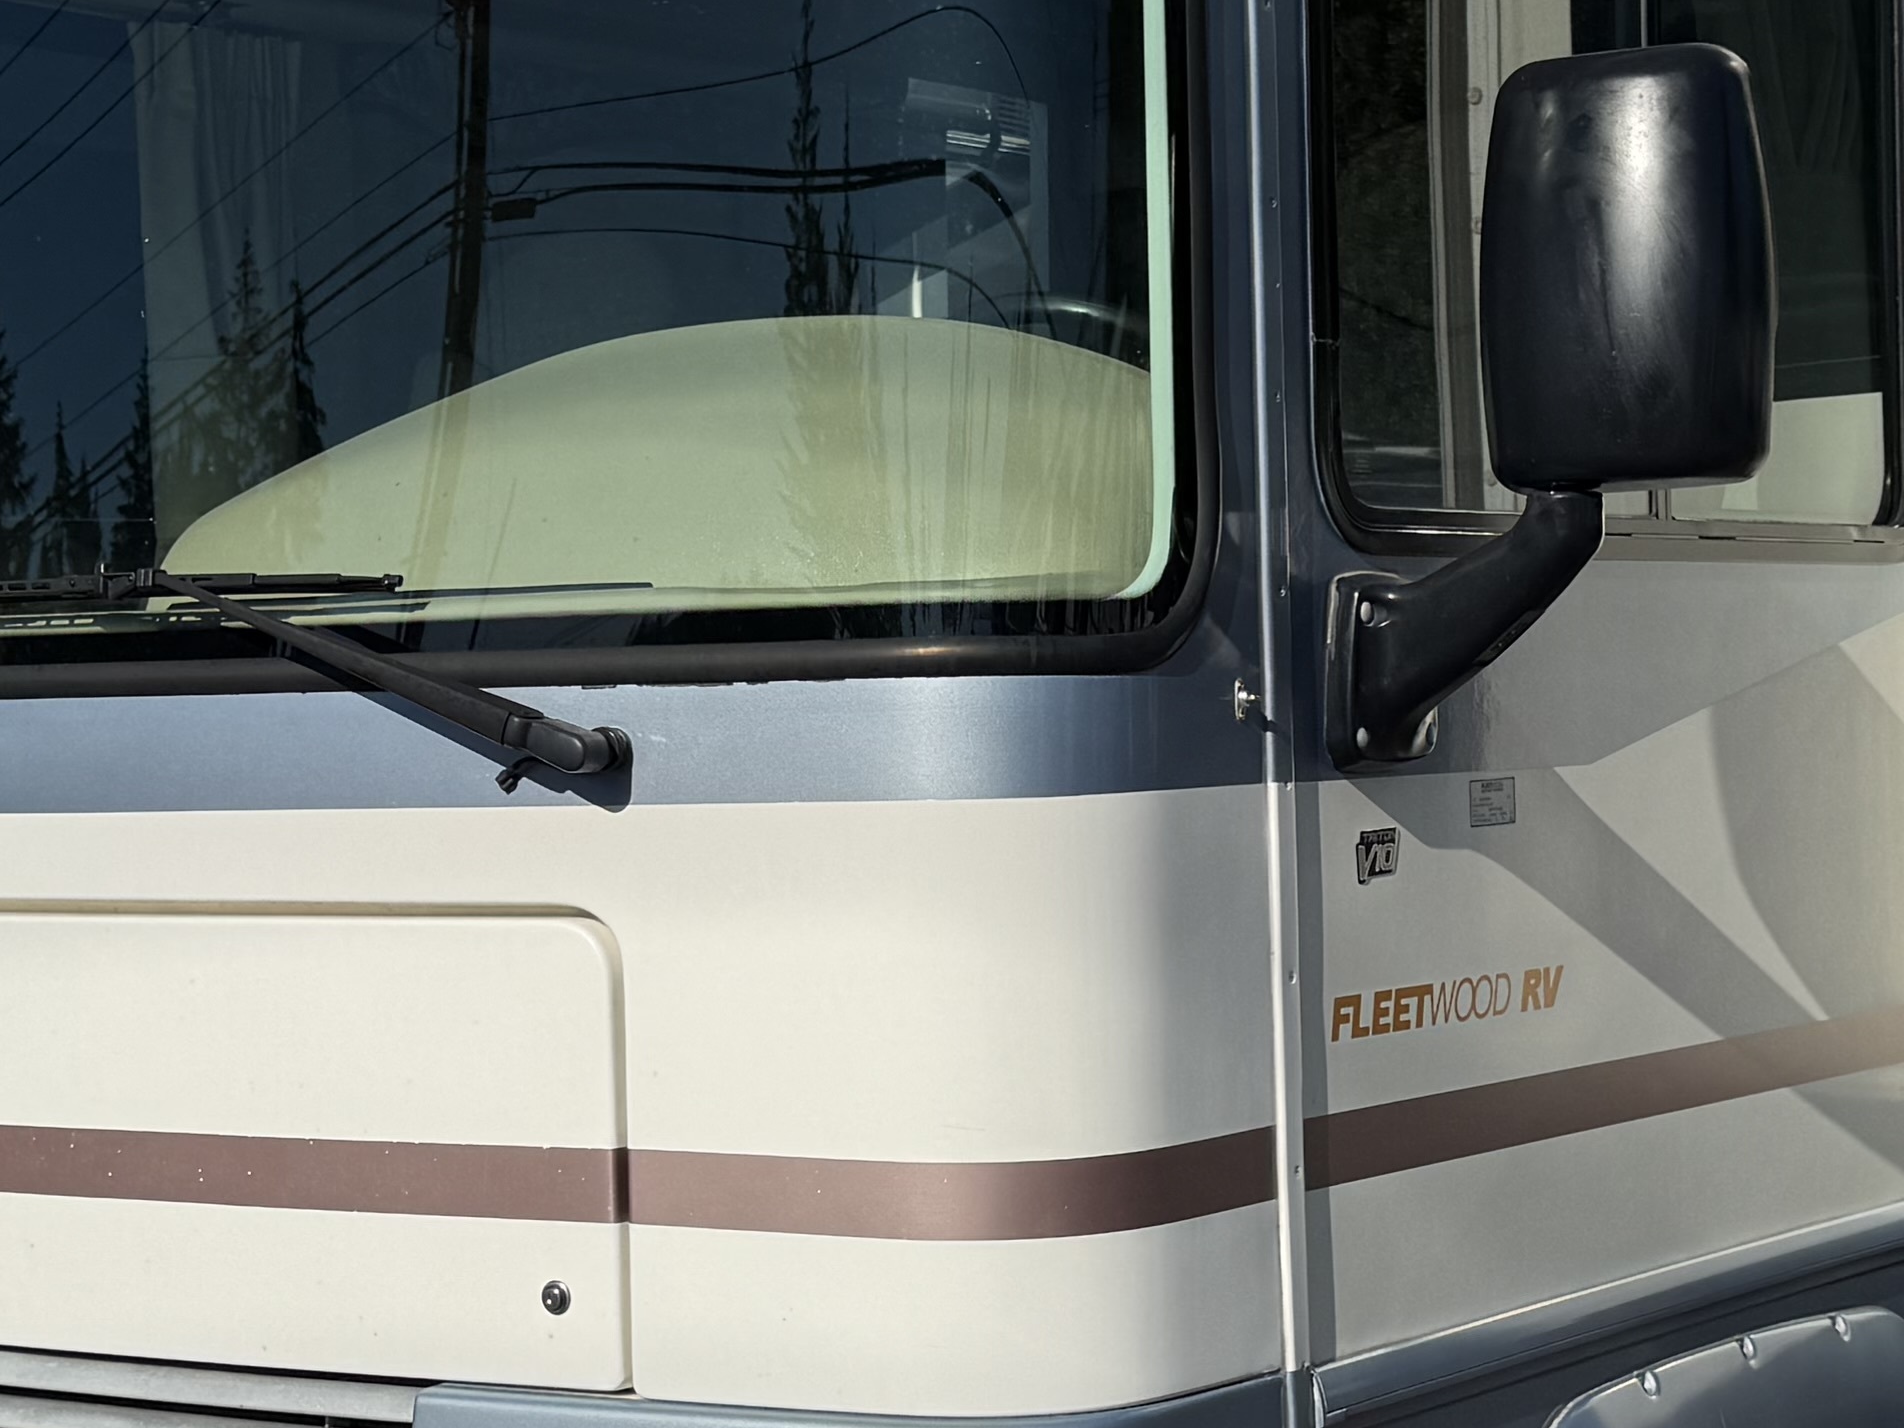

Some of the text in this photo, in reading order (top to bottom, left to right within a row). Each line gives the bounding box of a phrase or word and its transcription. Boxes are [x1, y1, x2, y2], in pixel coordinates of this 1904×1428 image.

[1357, 842, 1395, 881] V10
[1330, 964, 1564, 1043] FLEETWOOD RV
